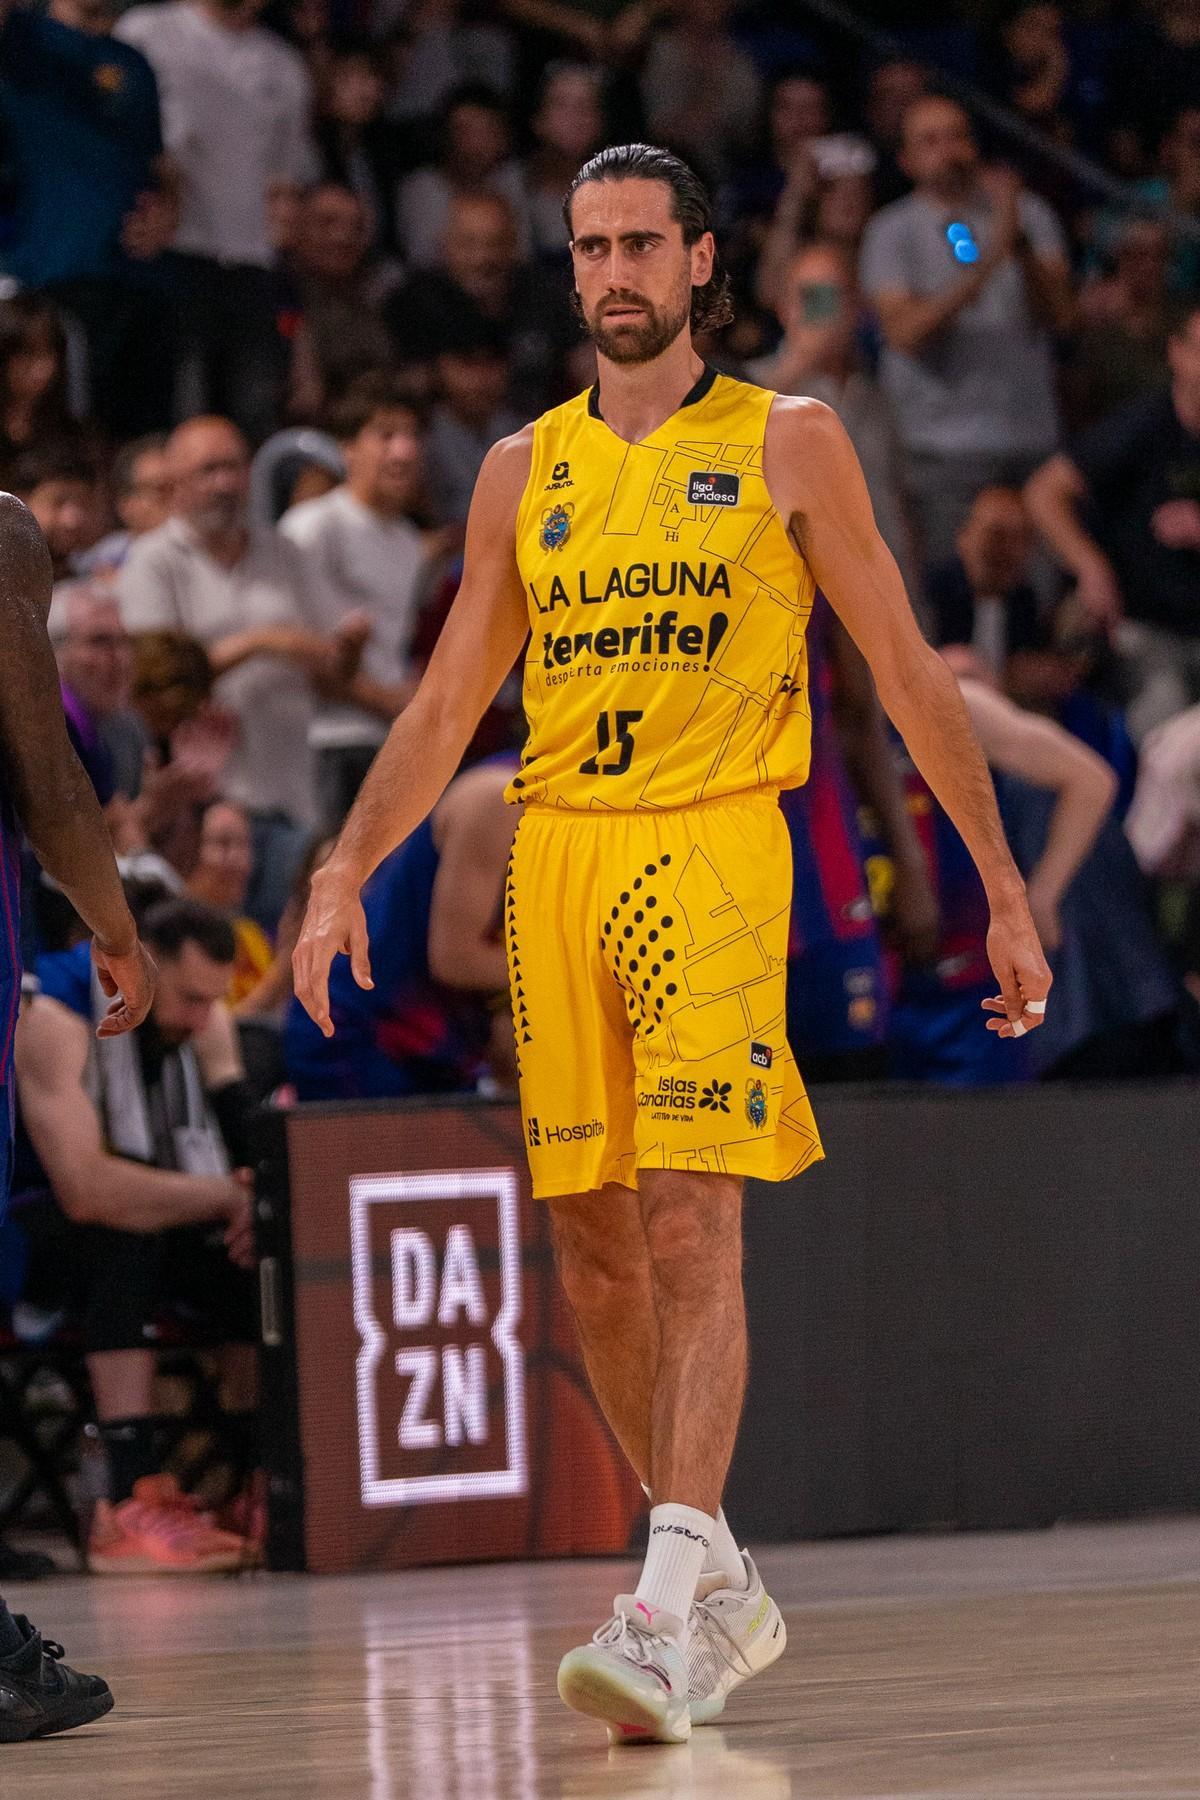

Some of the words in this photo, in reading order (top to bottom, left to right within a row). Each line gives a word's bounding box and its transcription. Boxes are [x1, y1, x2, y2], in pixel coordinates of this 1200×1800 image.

[692, 481, 713, 492] liga
[691, 491, 736, 503] endesa
[670, 503, 680, 513] A
[664, 531, 680, 542] Hi
[529, 575, 571, 614] LA
[579, 561, 732, 605] LAGUNA
[545, 662, 602, 687] despirta
[610, 658, 700, 674] emociones
[579, 710, 644, 776] 15
[752, 1052, 768, 1066] acb
[658, 1076, 697, 1094] Islas
[637, 1092, 695, 1109] Canarias
